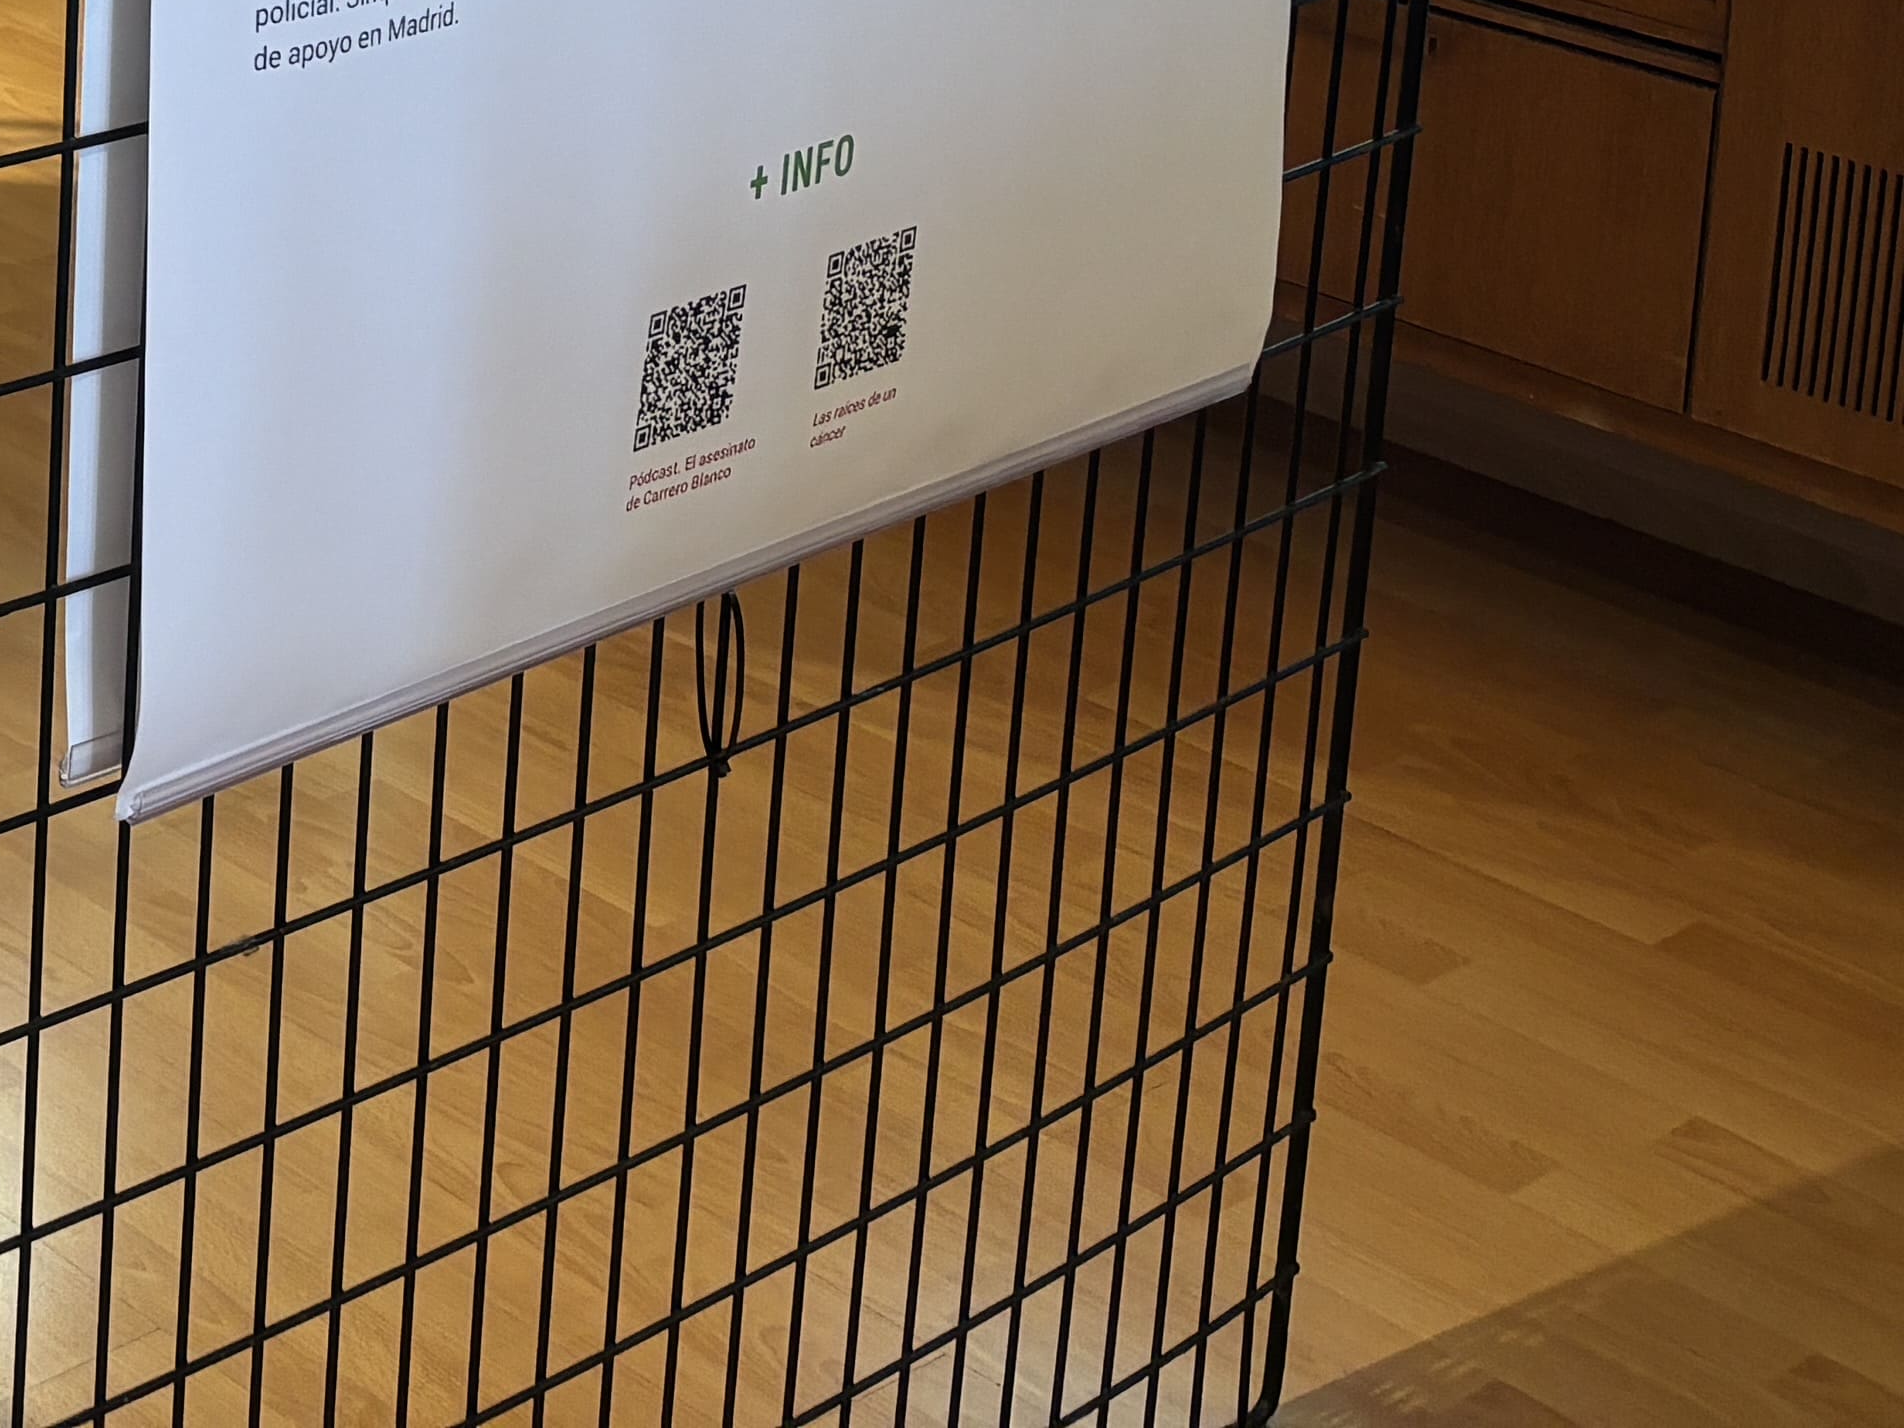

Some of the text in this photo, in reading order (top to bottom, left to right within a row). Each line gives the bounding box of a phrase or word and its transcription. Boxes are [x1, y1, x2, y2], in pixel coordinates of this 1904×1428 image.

[780, 134, 854, 195] INFO
[629, 438, 755, 488] Pódcast. El asesinato
[626, 467, 731, 512] de Carrero Blanco
